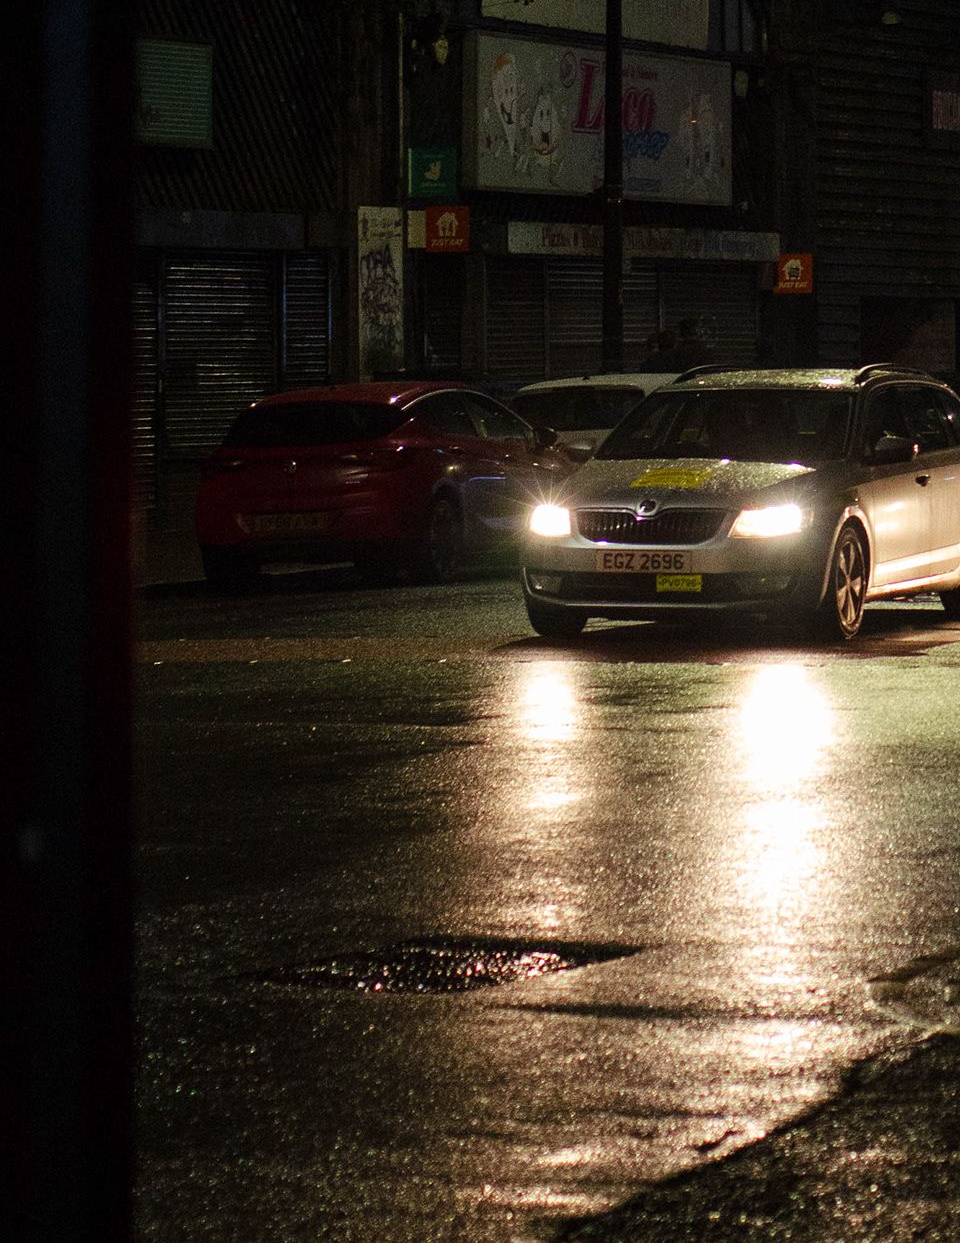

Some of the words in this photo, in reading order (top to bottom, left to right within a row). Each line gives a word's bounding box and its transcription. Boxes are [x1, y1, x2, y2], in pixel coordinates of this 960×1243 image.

[572, 58, 657, 134] Lco
[603, 553, 635, 569] EGZ
[640, 554, 684, 570] 2696
